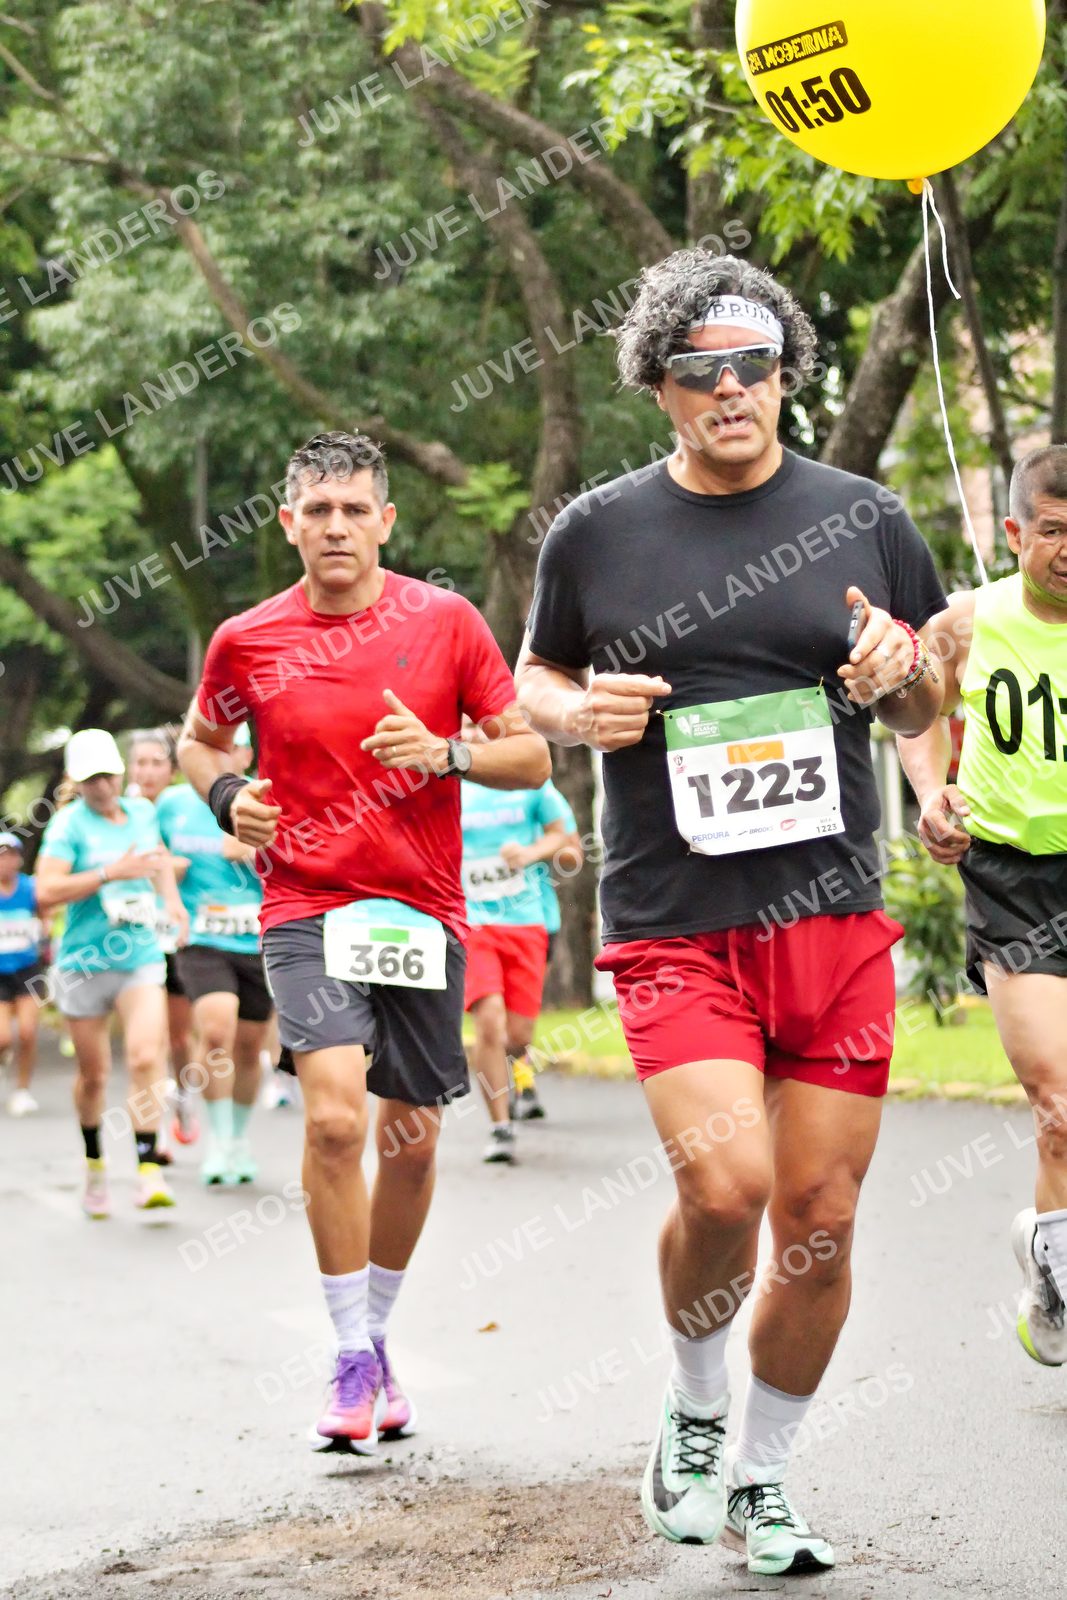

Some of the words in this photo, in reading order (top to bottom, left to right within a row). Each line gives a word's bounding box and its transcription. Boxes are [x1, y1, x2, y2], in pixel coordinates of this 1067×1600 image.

[765, 67, 871, 133] 01:50
[688, 756, 826, 818] 1223
[692, 831, 730, 843] PERDURA
[816, 823, 837, 834] 1223
[349, 944, 424, 981] 366
